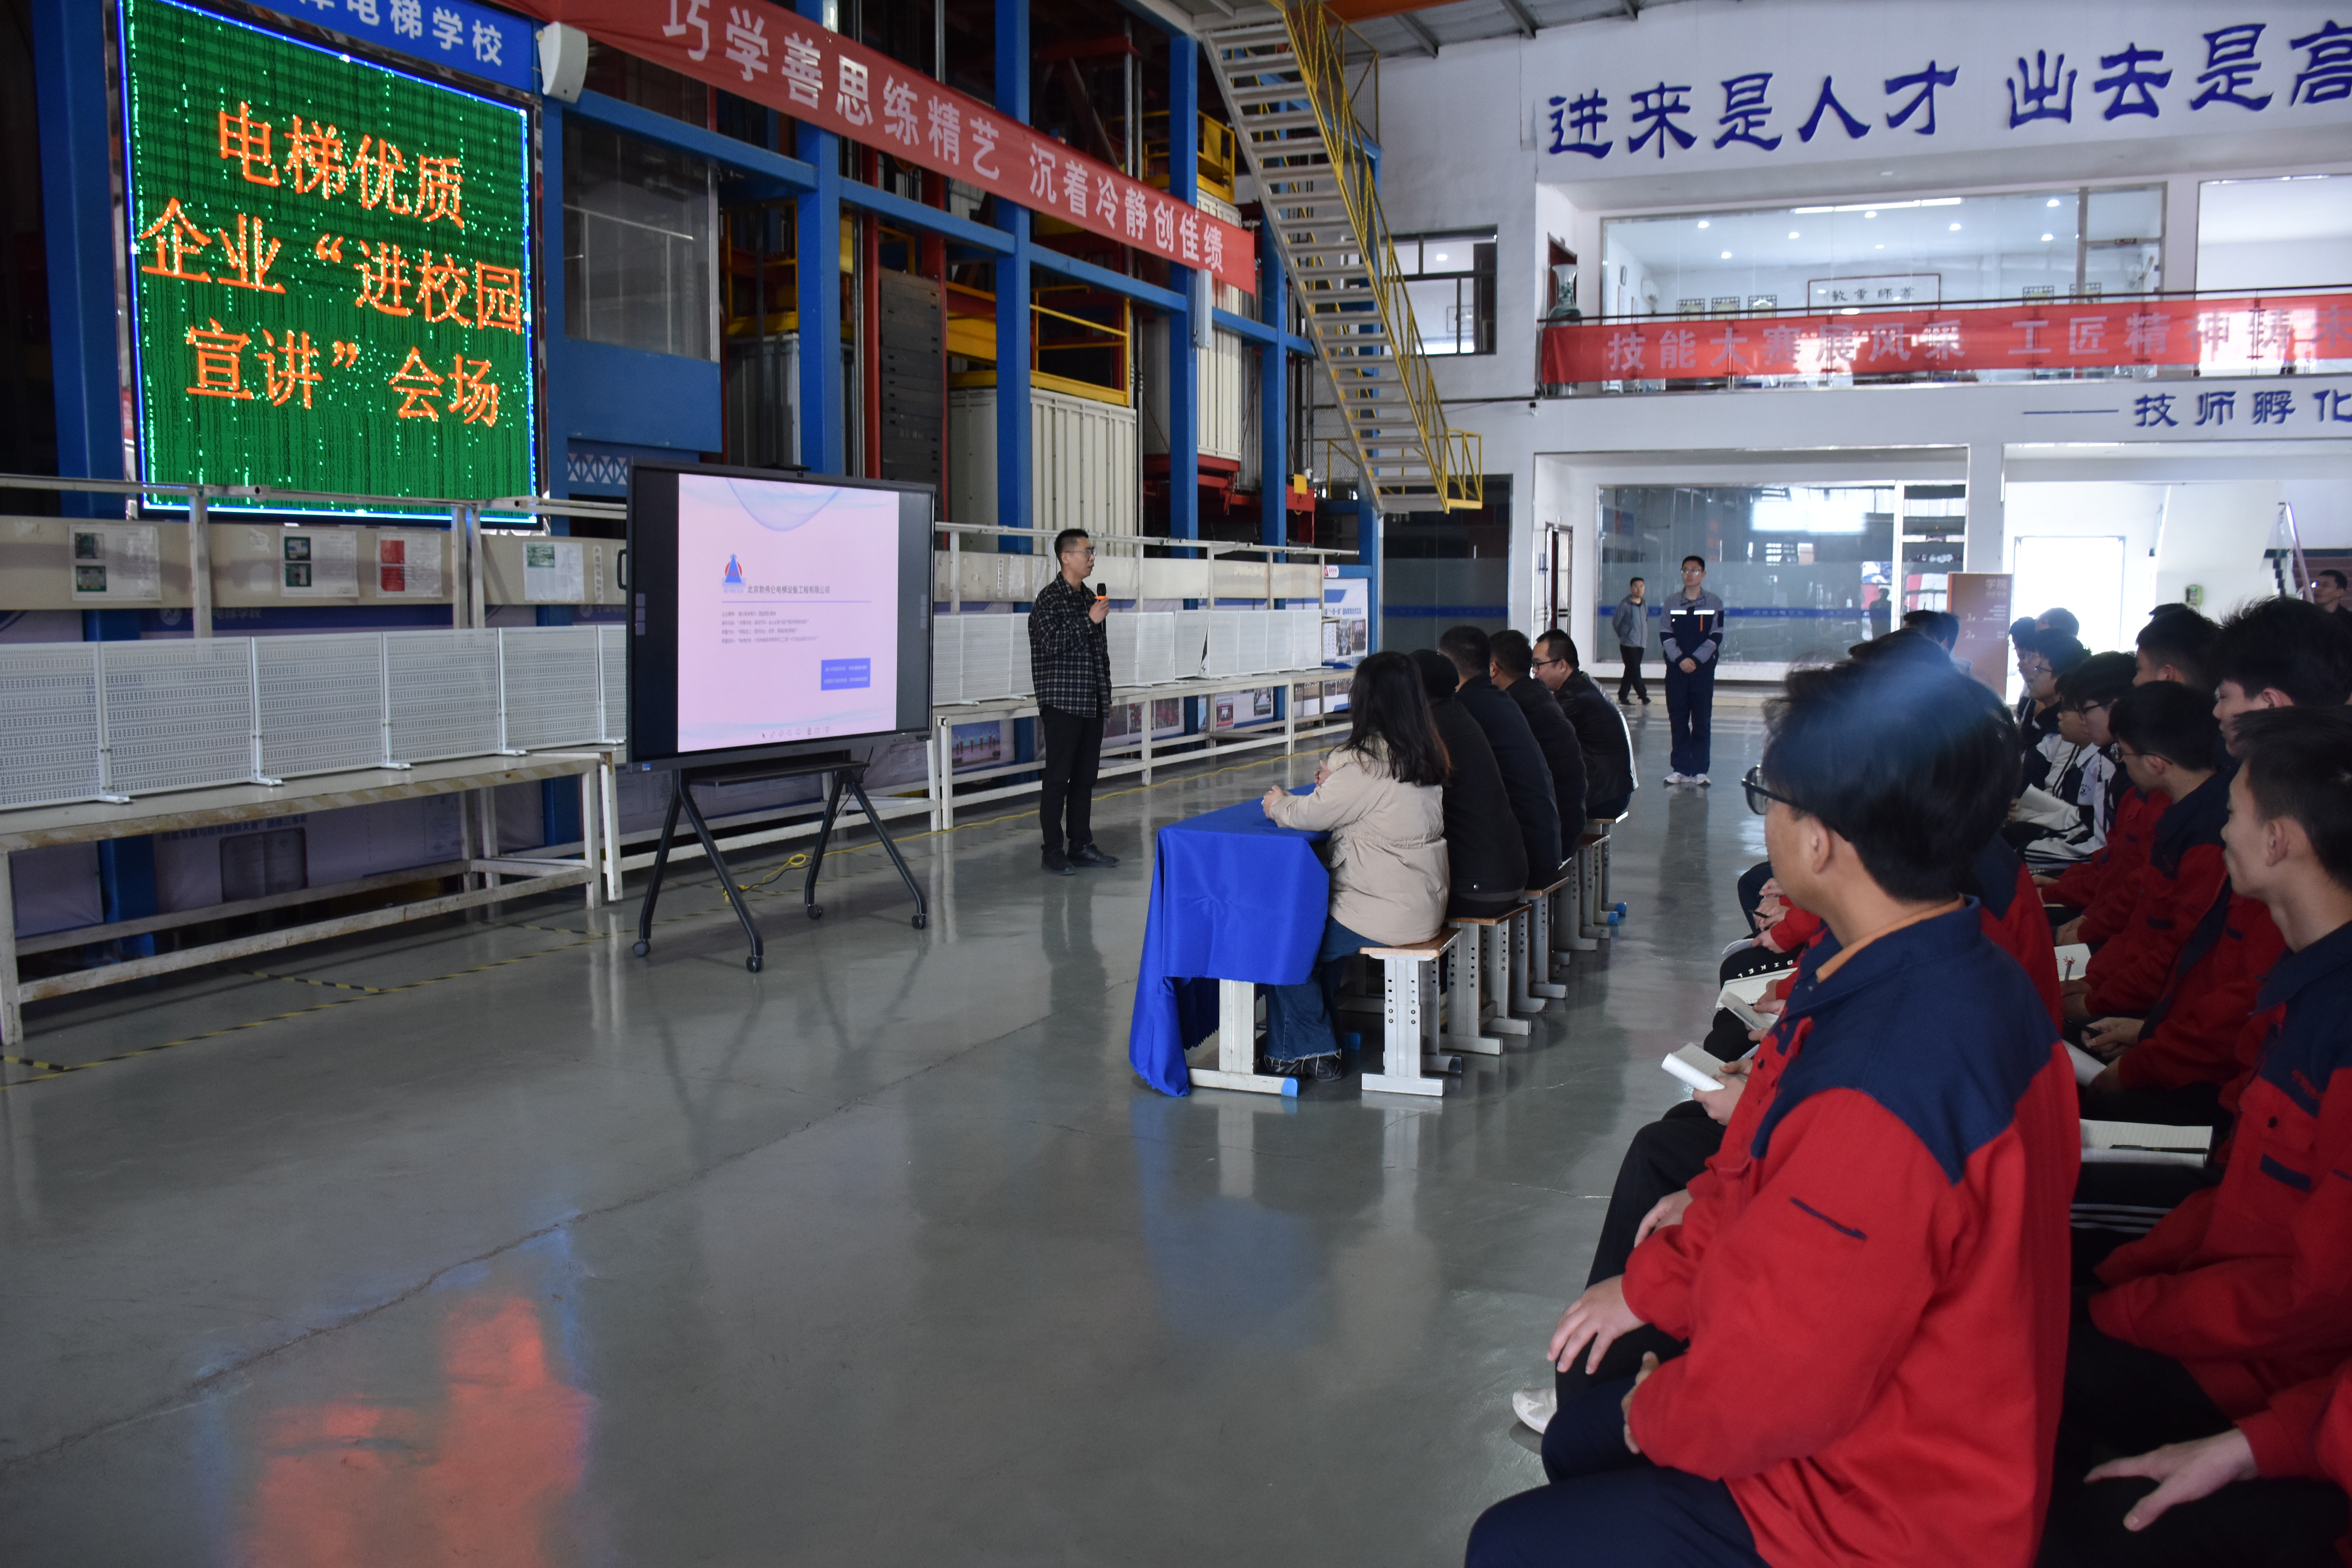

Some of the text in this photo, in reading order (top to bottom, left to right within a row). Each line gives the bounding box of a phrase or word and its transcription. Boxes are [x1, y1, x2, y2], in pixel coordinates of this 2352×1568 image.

[300, 0, 502, 66] 电梯学校
[1548, 20, 2352, 159] 进来是人才 出去是高
[218, 101, 464, 229] 电梯优质
[662, 0, 1223, 273] 巧学善思练精艺 沉着冷静创佳绩
[1607, 319, 1965, 372] 技能大赛展风采
